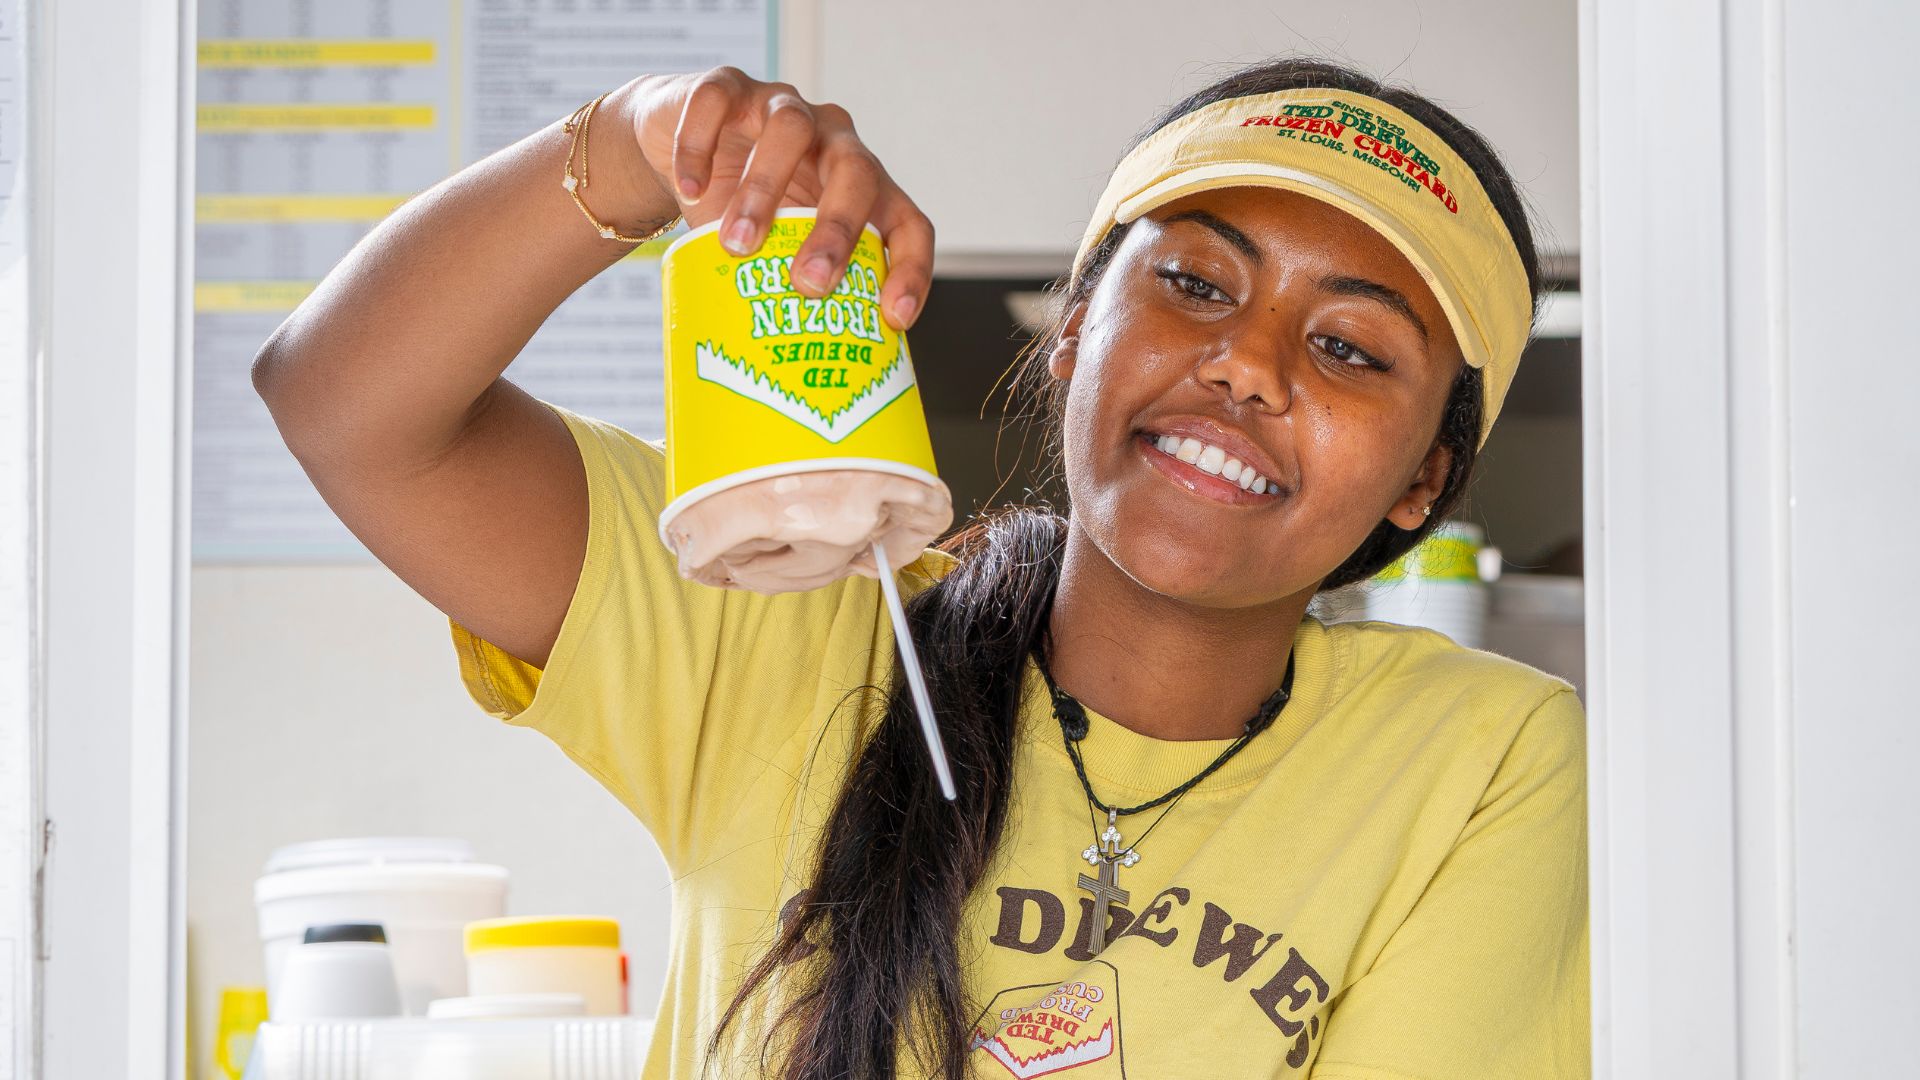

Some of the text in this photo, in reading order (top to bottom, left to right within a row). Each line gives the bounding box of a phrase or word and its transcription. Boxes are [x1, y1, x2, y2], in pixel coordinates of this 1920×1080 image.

[1332, 101, 1373, 120] SINCE
[1240, 114, 1458, 214] FROZEN CUSTARD
[1277, 129, 1422, 193] ST. LOUIS, MISSOURI
[1282, 104, 1441, 176] TED DREWES
[749, 296, 885, 344] FROZEN
[803, 368, 849, 388] TED
[1006, 1023, 1055, 1046] TED
